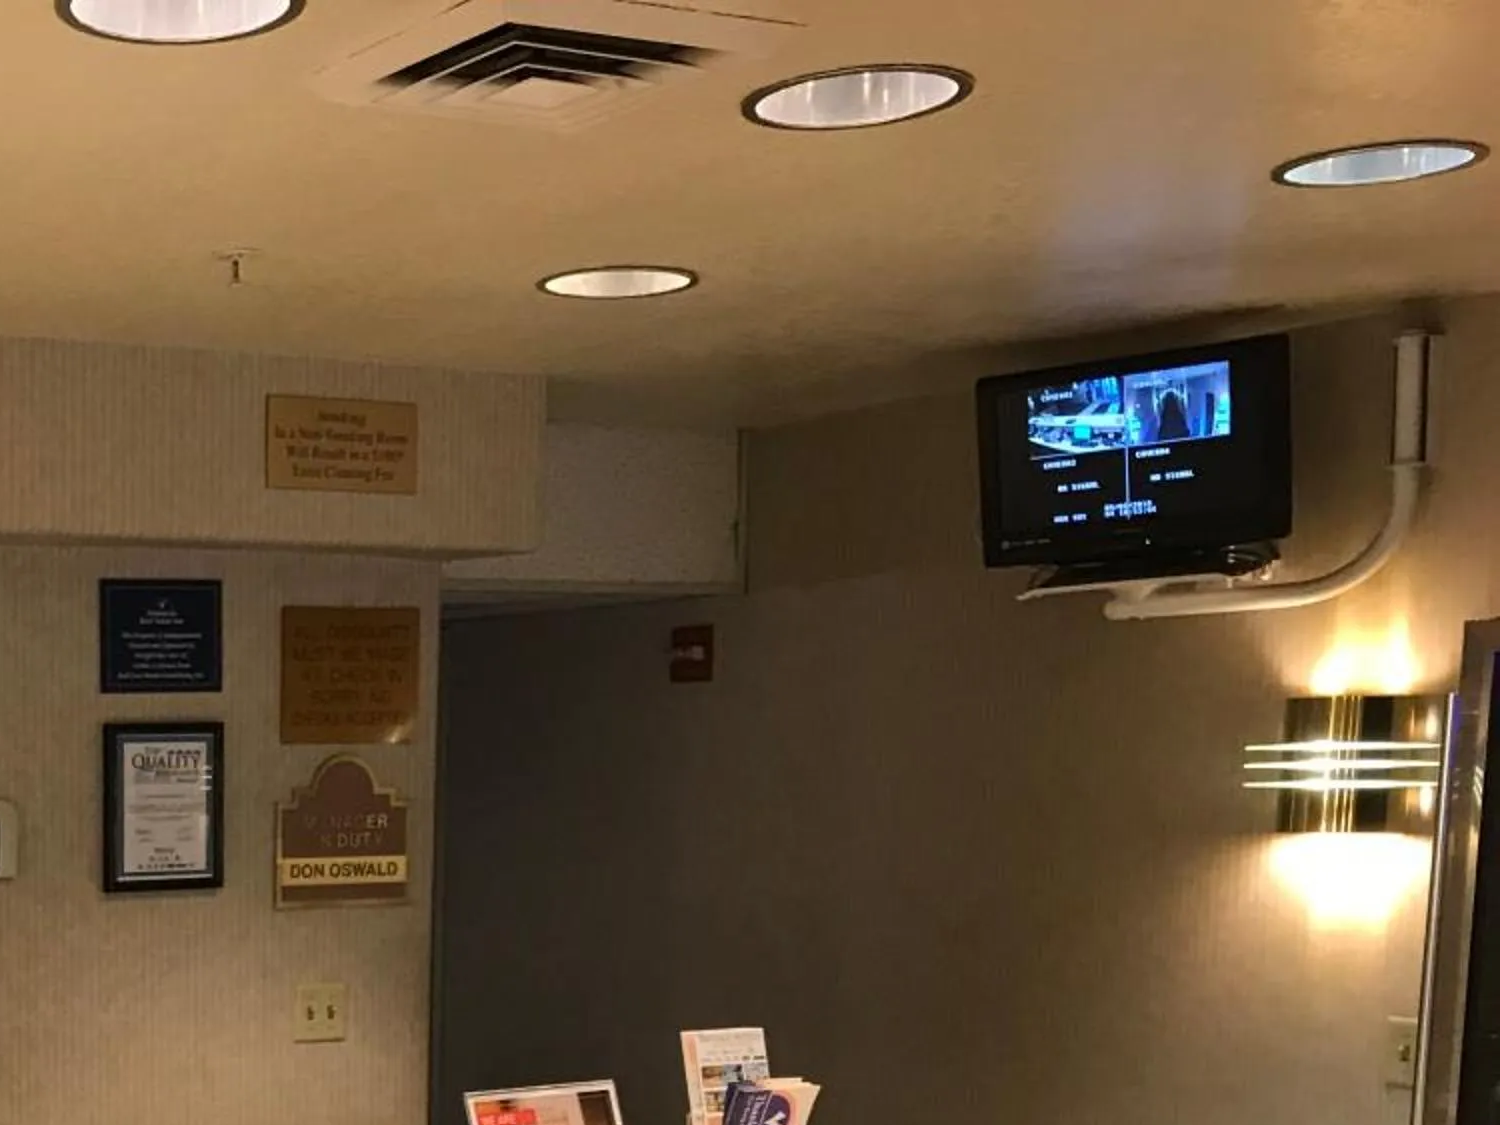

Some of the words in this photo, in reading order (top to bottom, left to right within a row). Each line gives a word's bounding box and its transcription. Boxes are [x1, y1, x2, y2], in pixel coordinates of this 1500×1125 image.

[131, 752, 199, 771] QUALITY
[337, 831, 384, 848] DUTY
[290, 863, 326, 880] DON
[329, 860, 398, 878] OSWALD
